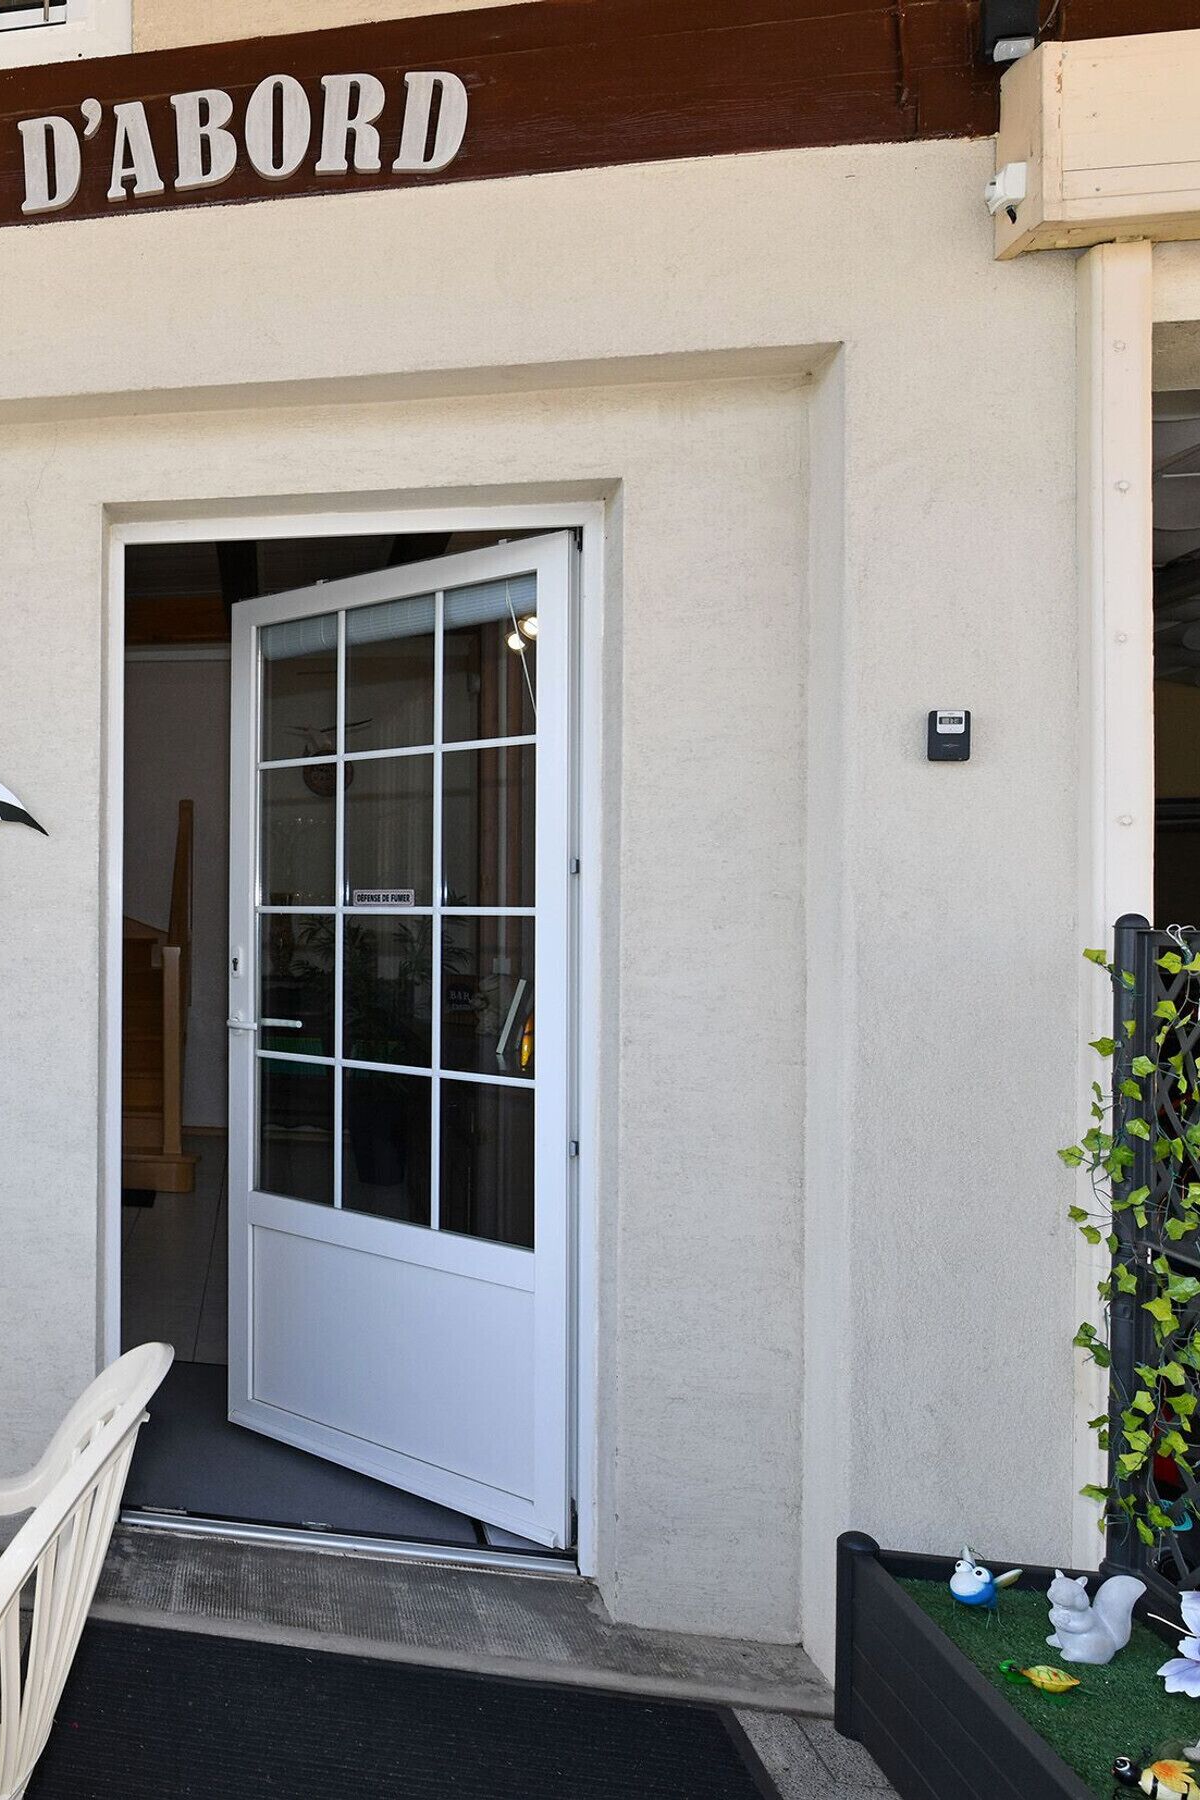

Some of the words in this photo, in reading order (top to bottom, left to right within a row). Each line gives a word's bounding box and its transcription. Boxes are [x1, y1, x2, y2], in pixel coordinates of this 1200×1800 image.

[17, 71, 468, 215] D'ABORD
[382, 894, 389, 902] DE
[391, 894, 410, 902] FUMER
